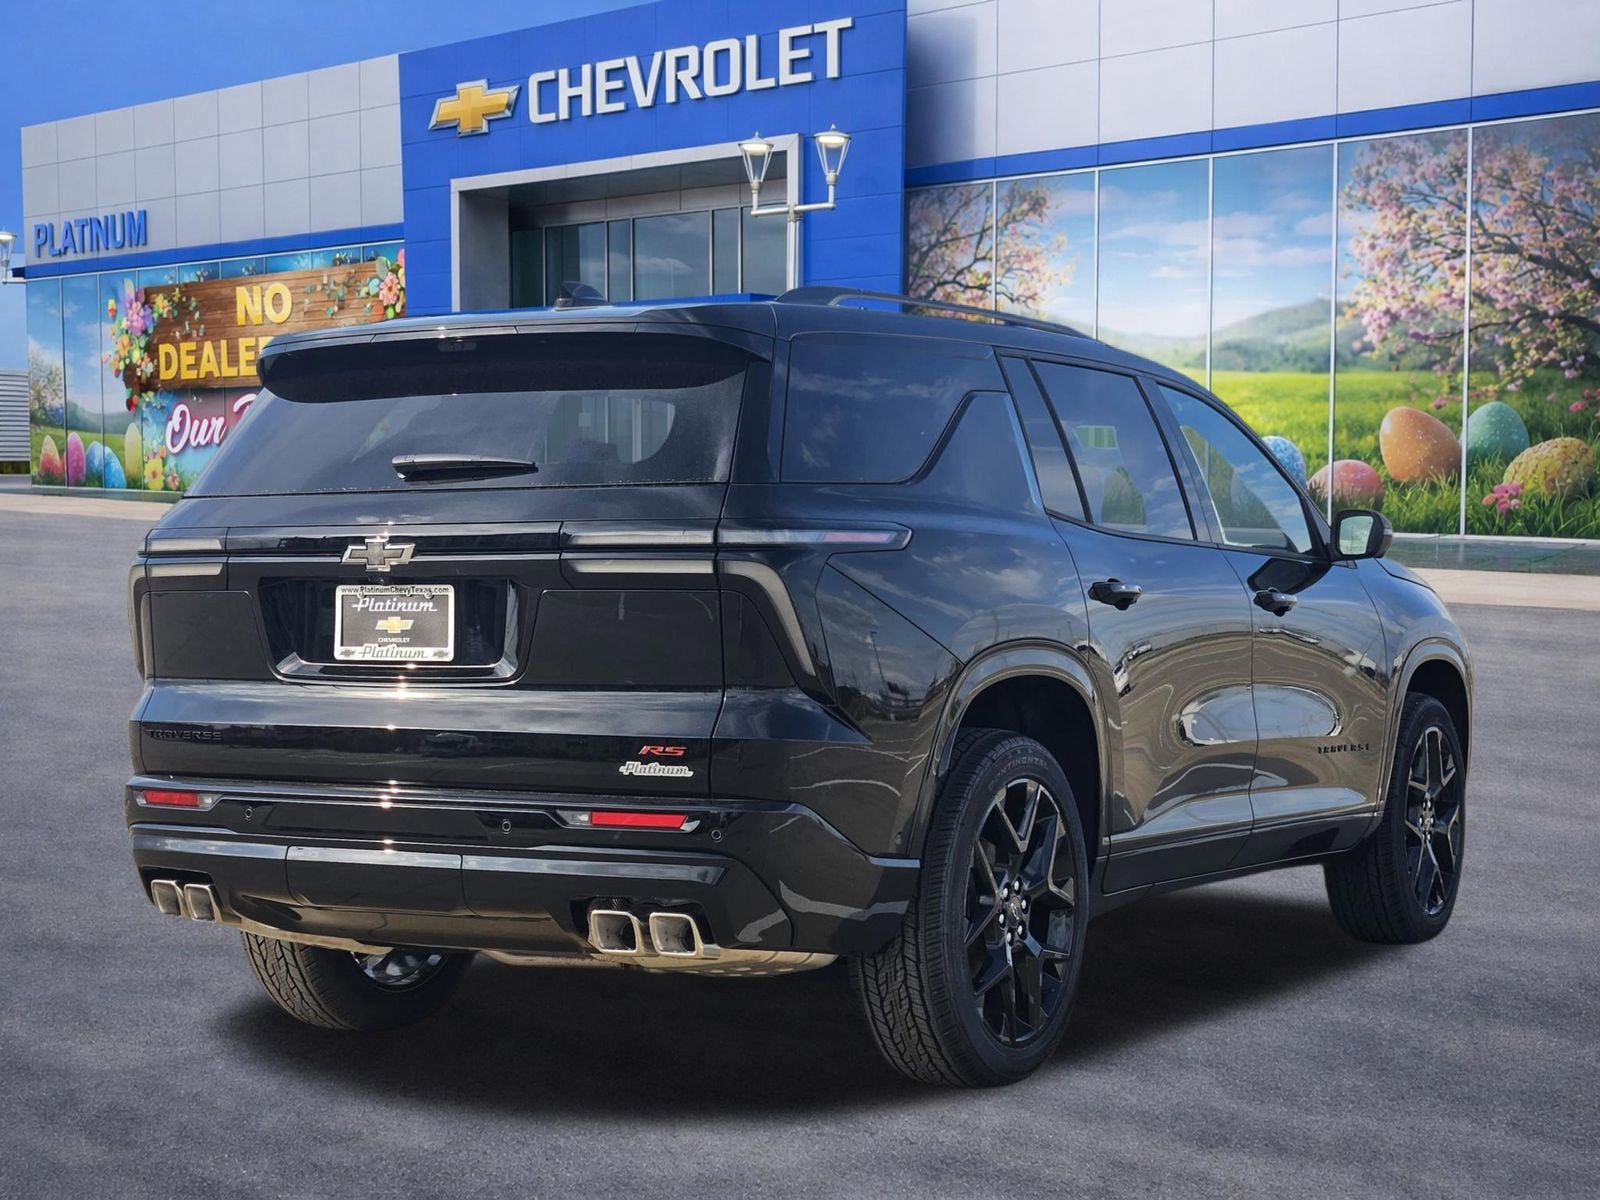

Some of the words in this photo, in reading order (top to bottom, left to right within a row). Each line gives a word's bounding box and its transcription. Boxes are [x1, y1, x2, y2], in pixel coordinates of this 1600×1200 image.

[528, 16, 854, 125] CHEVROLET
[33, 209, 148, 259] PLATINUM
[235, 281, 294, 327] NO
[165, 404, 228, 454] Our
[341, 586, 449, 595] www.PlatinumChevyTexas.com
[352, 598, 438, 612] Platinum
[359, 645, 429, 659] Platinum
[145, 728, 223, 741] TRAVERSE
[638, 745, 687, 757] RS
[619, 761, 694, 777] Platinum
